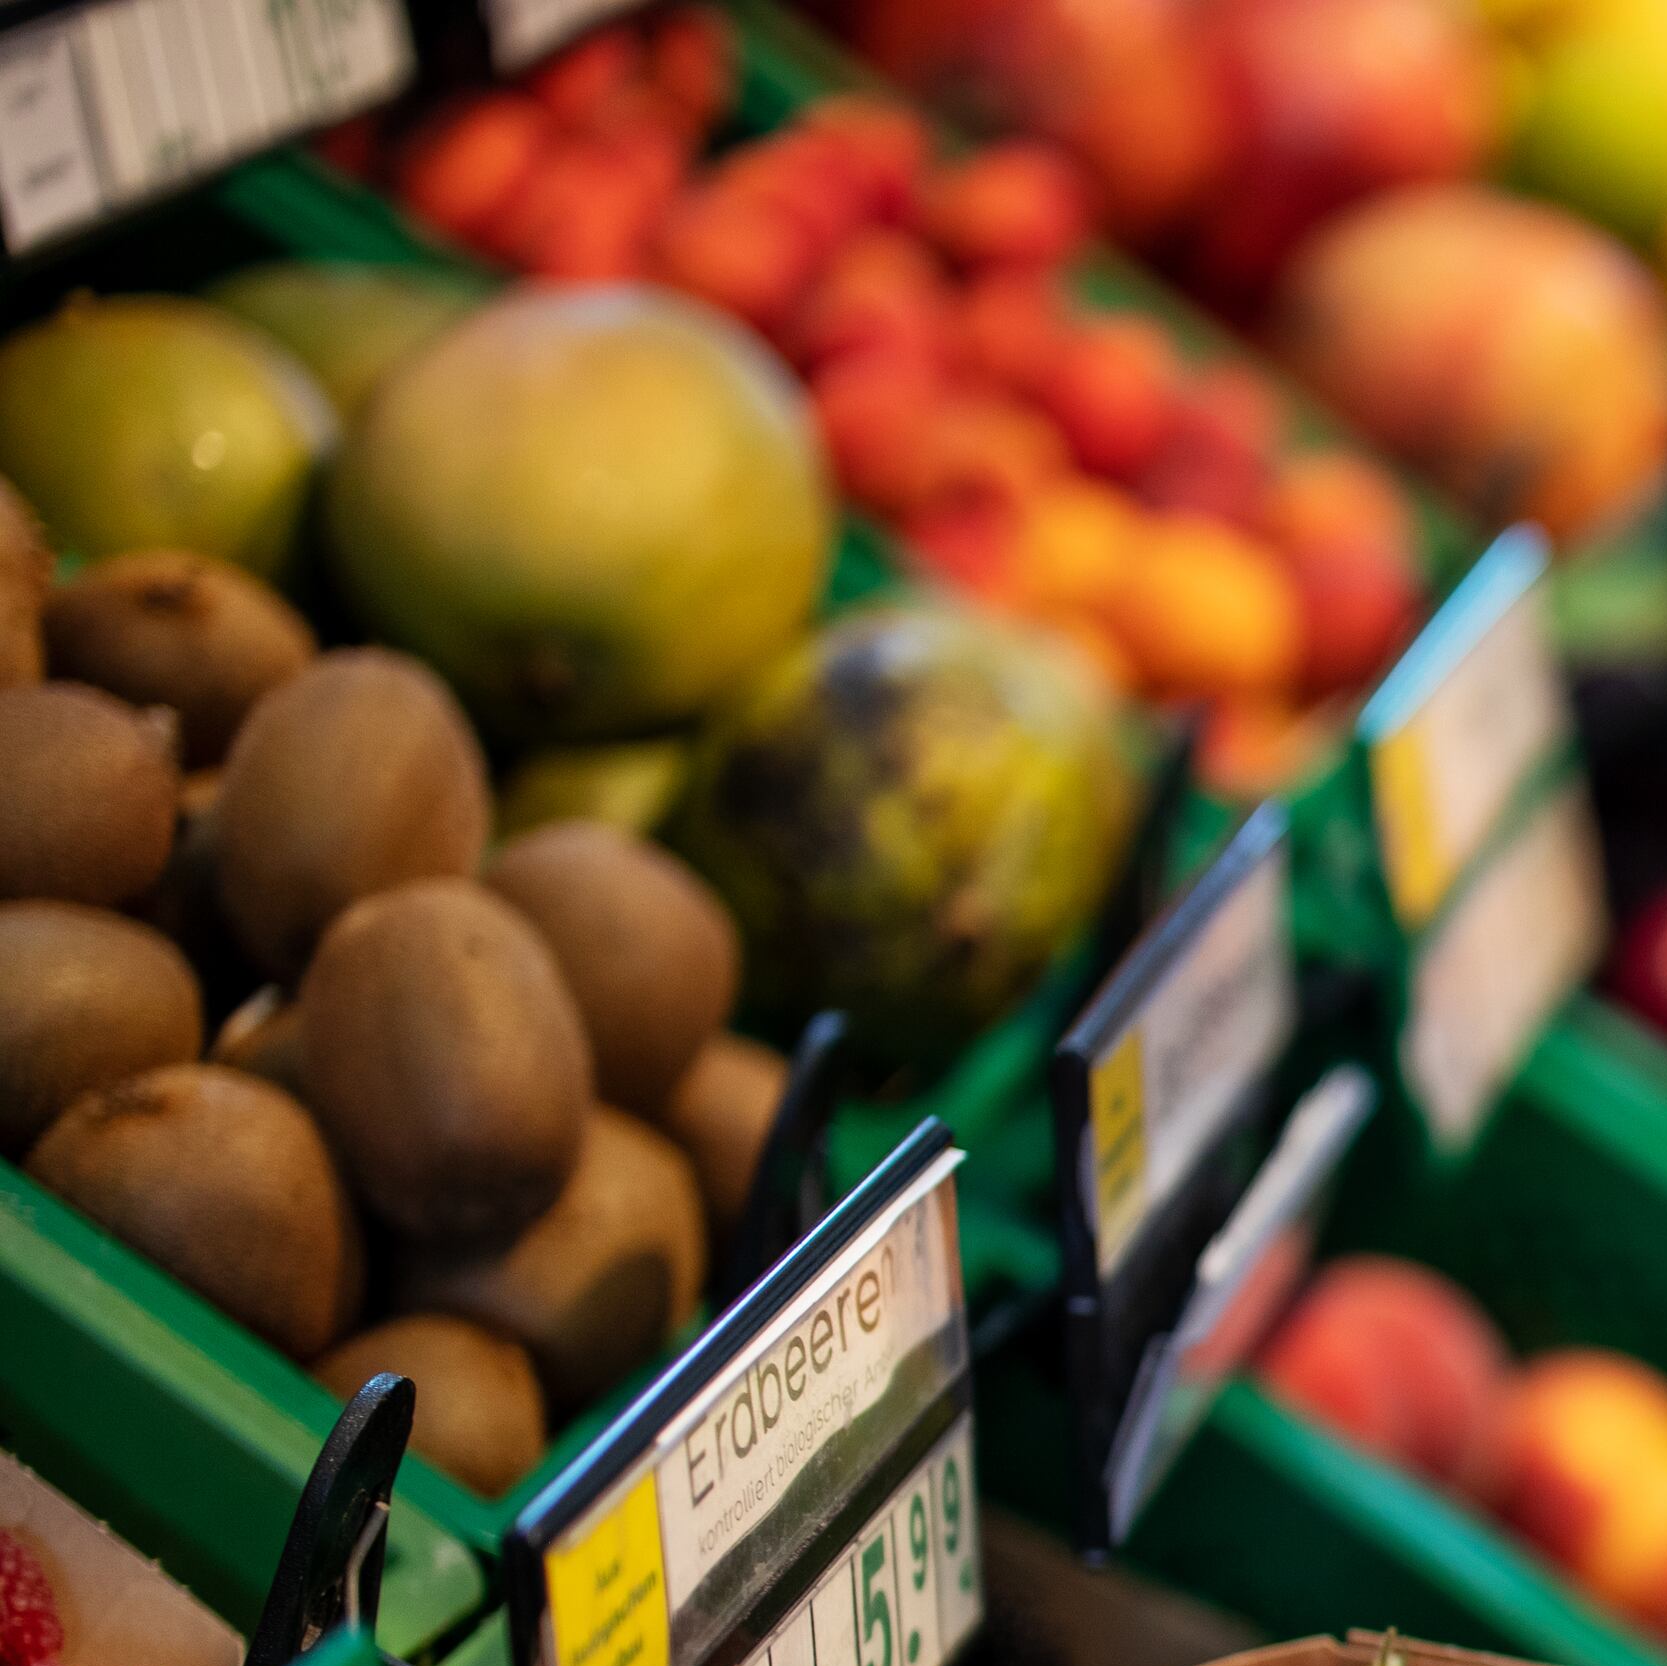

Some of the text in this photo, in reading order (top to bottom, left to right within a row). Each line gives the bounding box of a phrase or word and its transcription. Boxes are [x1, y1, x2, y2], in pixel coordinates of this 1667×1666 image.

[685, 1245, 896, 1509] Erdbeeren
[697, 1469, 775, 1556] kontrolliert
[777, 1380, 859, 1478] biologischer
